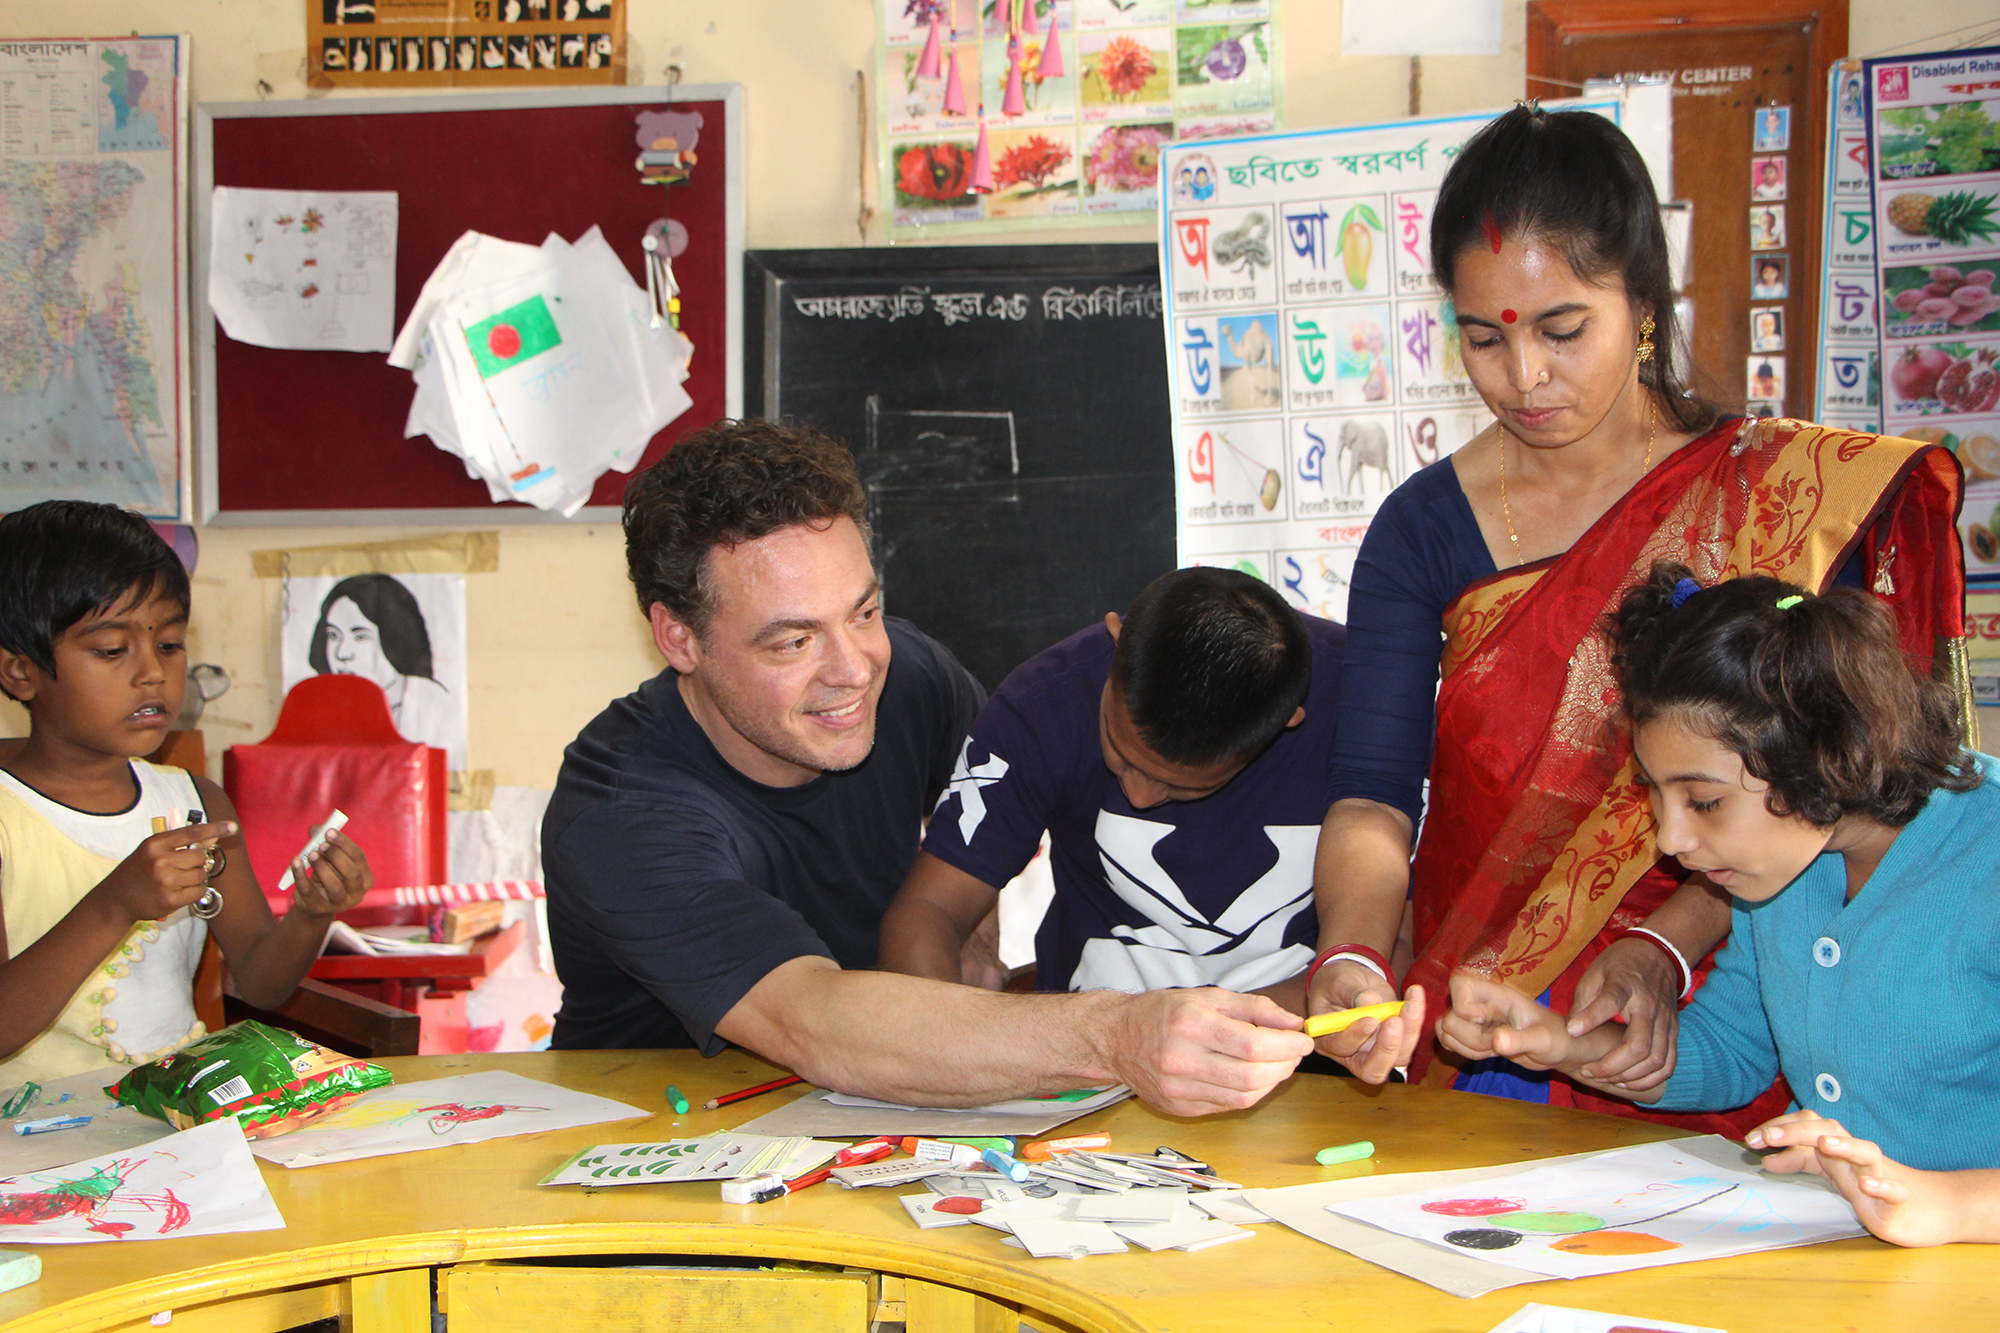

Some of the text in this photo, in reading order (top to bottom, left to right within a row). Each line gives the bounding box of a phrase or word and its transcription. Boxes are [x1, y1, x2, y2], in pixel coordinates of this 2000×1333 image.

[1680, 66, 1753, 84] CENTER
[1911, 61, 1966, 79] Disabled
[1224, 138, 1429, 189] ছবিতে স্বরবর্ণ
[1174, 217, 1211, 282] অ
[1285, 204, 1330, 272] আ
[1397, 195, 1425, 268] ই
[1839, 211, 1871, 245] চ
[1833, 279, 1872, 322] ট
[1182, 319, 1214, 396] উ
[1401, 308, 1437, 378] ঋ
[1830, 356, 1865, 389] ত
[1187, 430, 1216, 497] এ
[1298, 421, 1326, 491] ঐ
[1405, 417, 1440, 469] ও
[1282, 556, 1309, 604] ২
